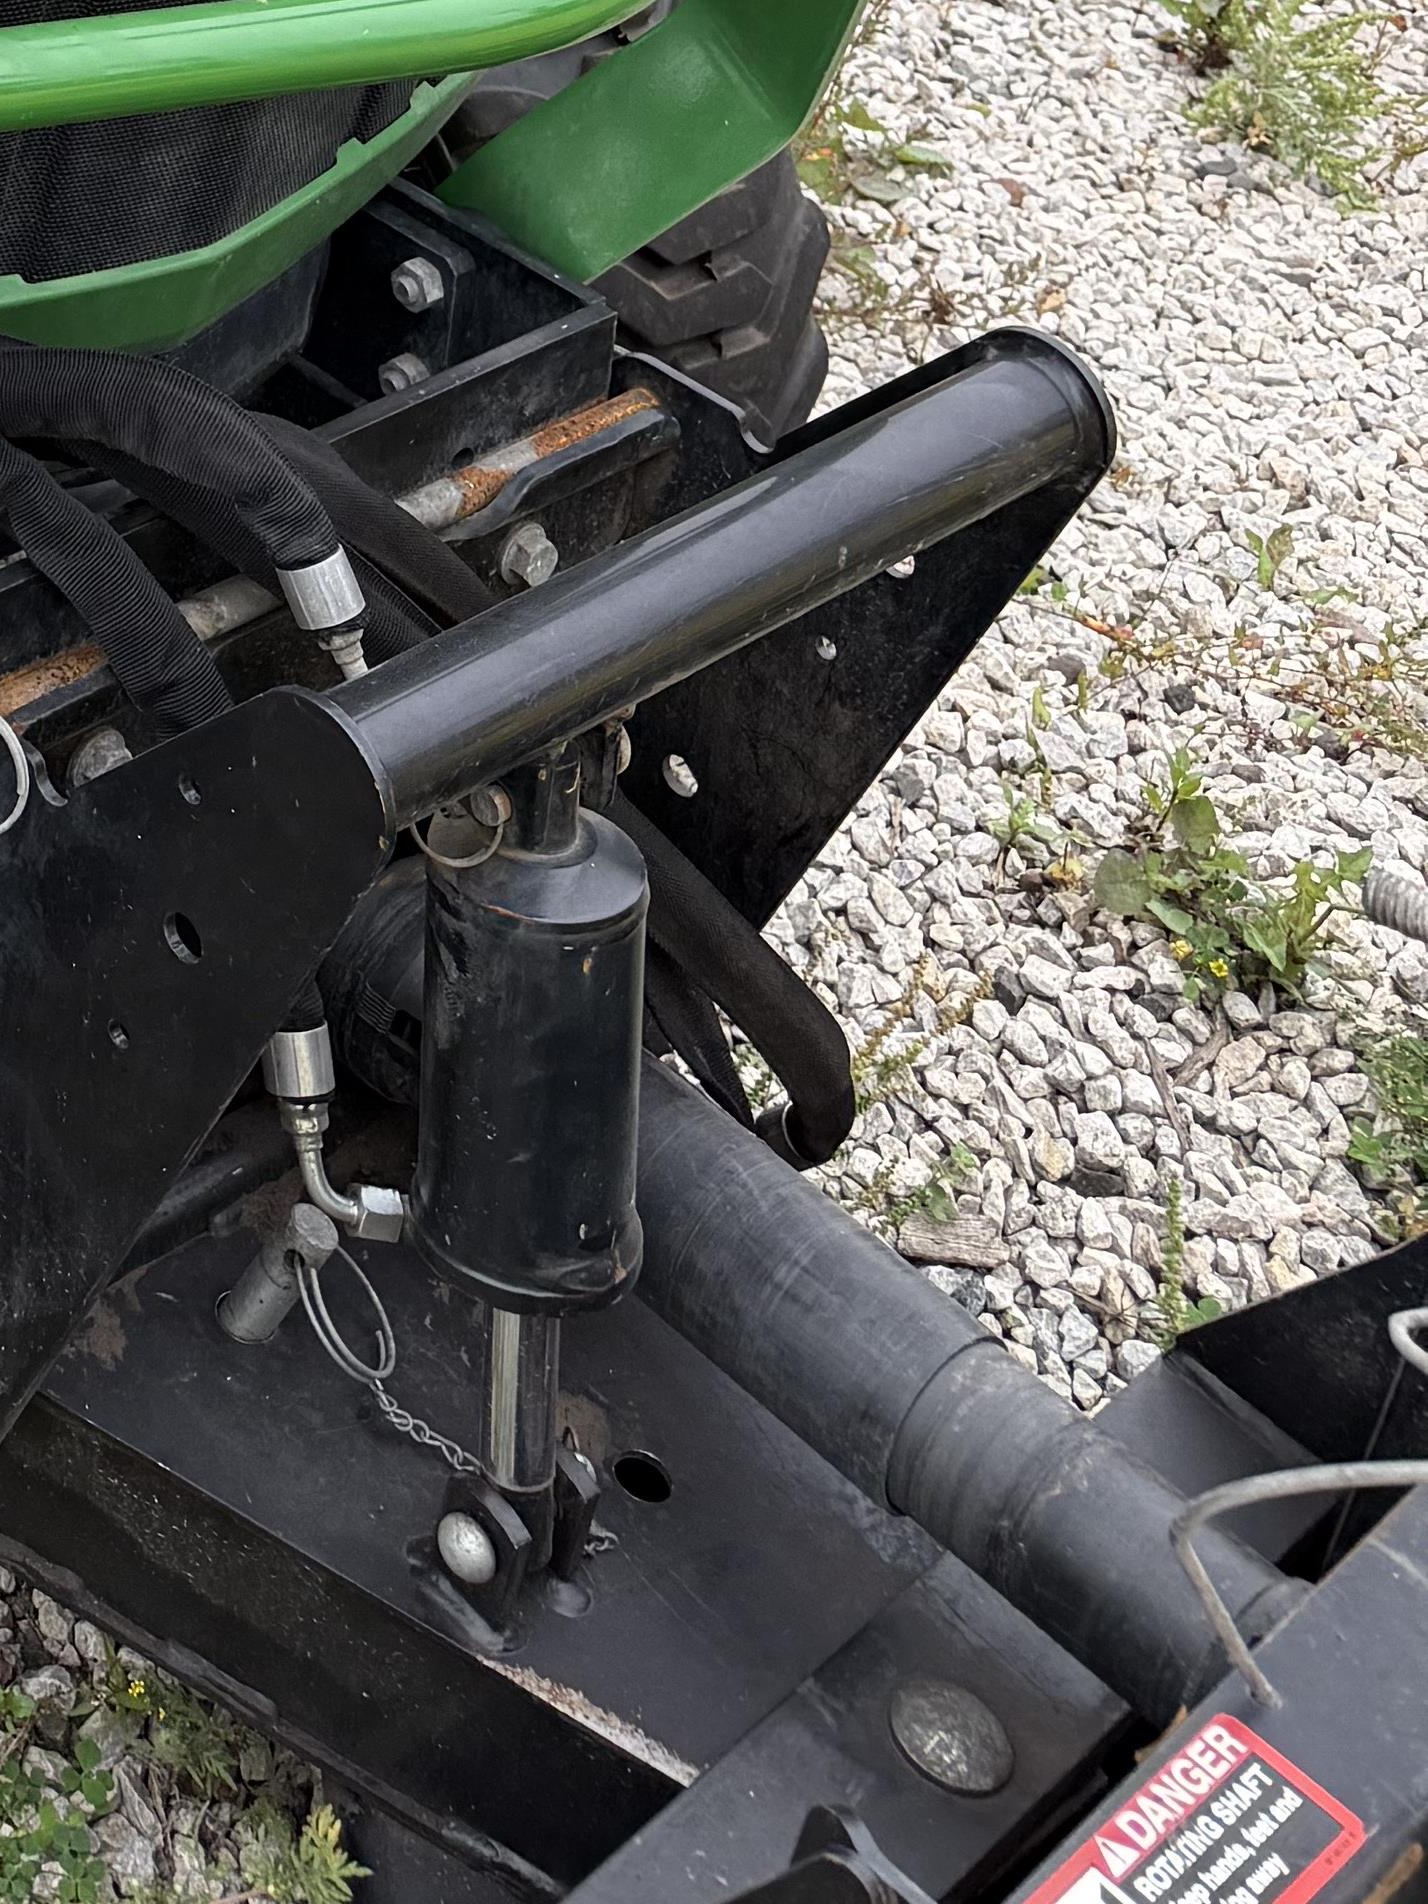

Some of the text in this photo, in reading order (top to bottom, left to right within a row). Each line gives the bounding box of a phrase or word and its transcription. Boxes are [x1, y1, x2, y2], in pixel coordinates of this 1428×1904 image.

[1116, 1724, 1249, 1851] DANGER
[1269, 1785, 1304, 1823] and
[1133, 1815, 1224, 1903] ROTATING
[1210, 1762, 1273, 1826] SHAFT
[1245, 1851, 1290, 1895] away
